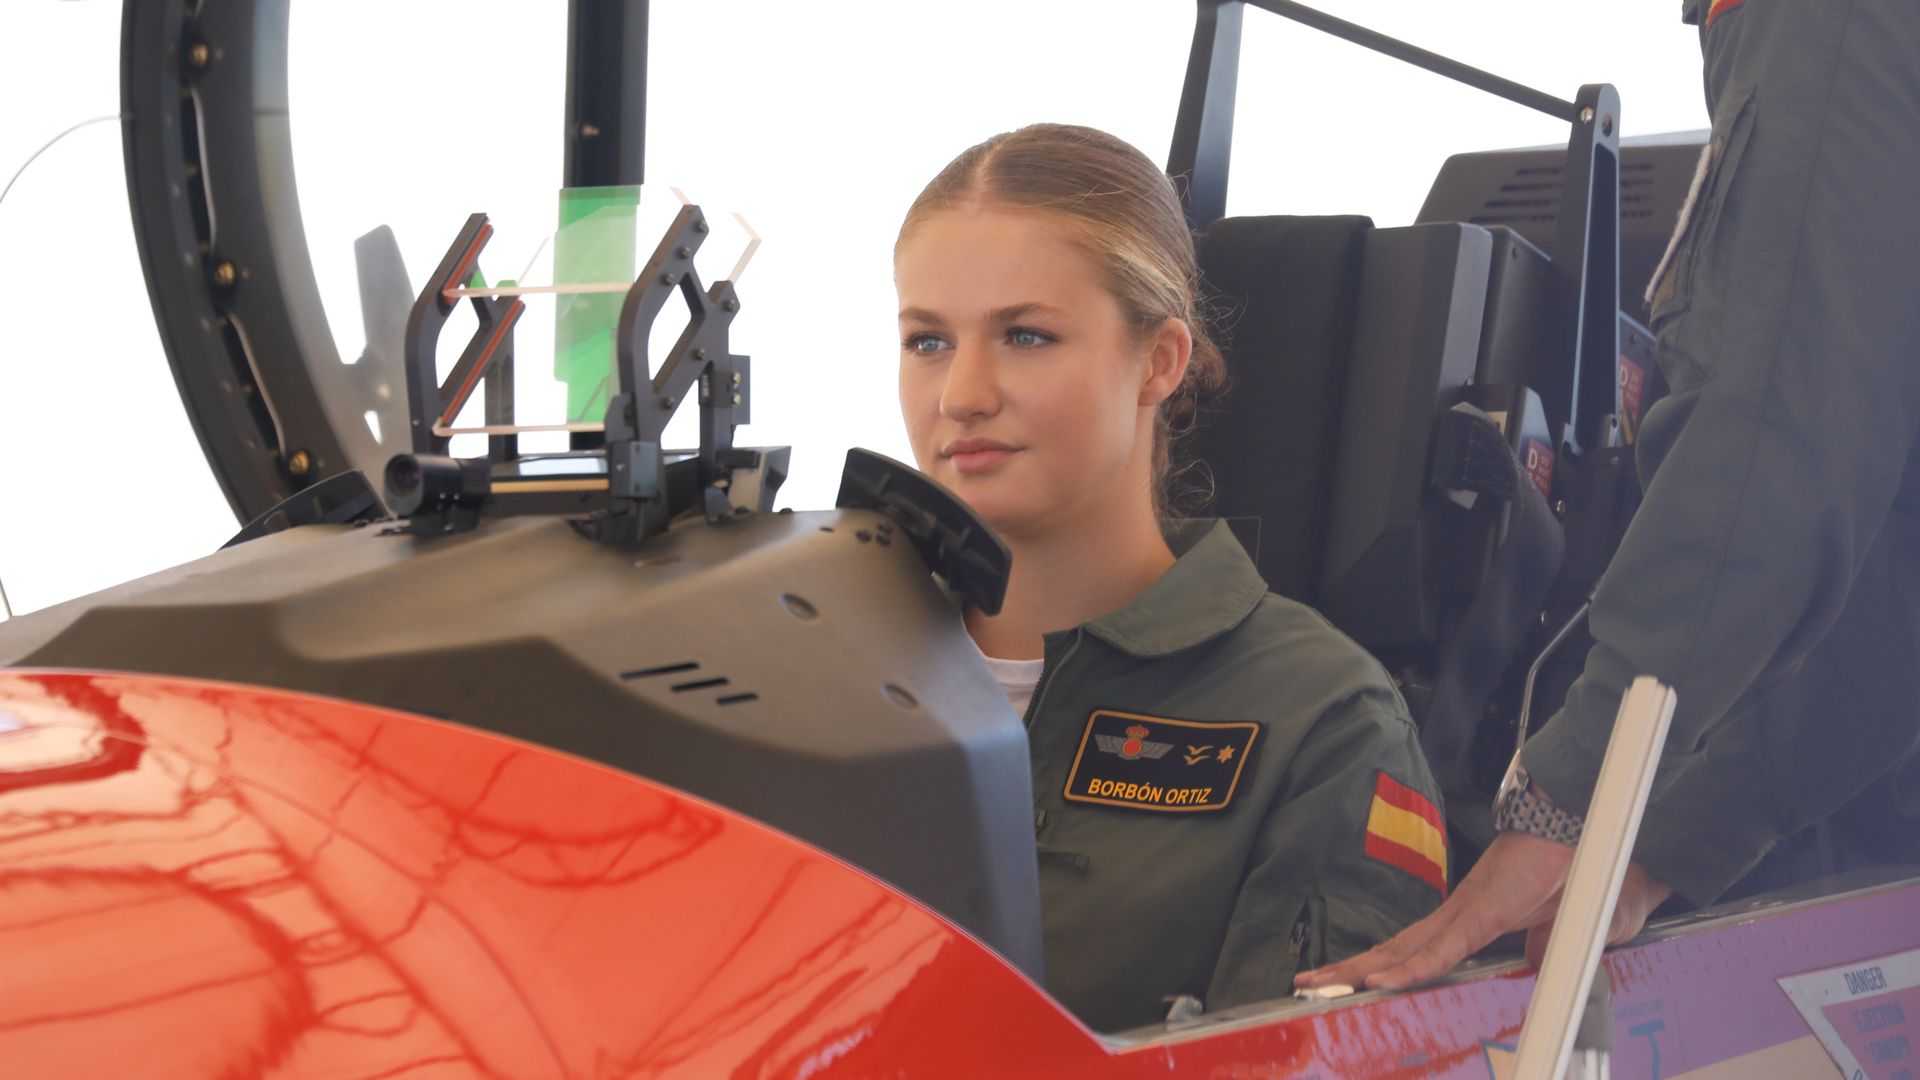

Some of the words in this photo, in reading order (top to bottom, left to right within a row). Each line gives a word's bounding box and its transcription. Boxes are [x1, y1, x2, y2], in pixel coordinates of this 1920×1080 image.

[1087, 778, 1163, 803] BORBÓN
[1164, 787, 1213, 804] ORTIZ
[1843, 965, 1888, 995] DANGER
[1852, 1001, 1908, 1034] EJECTION
